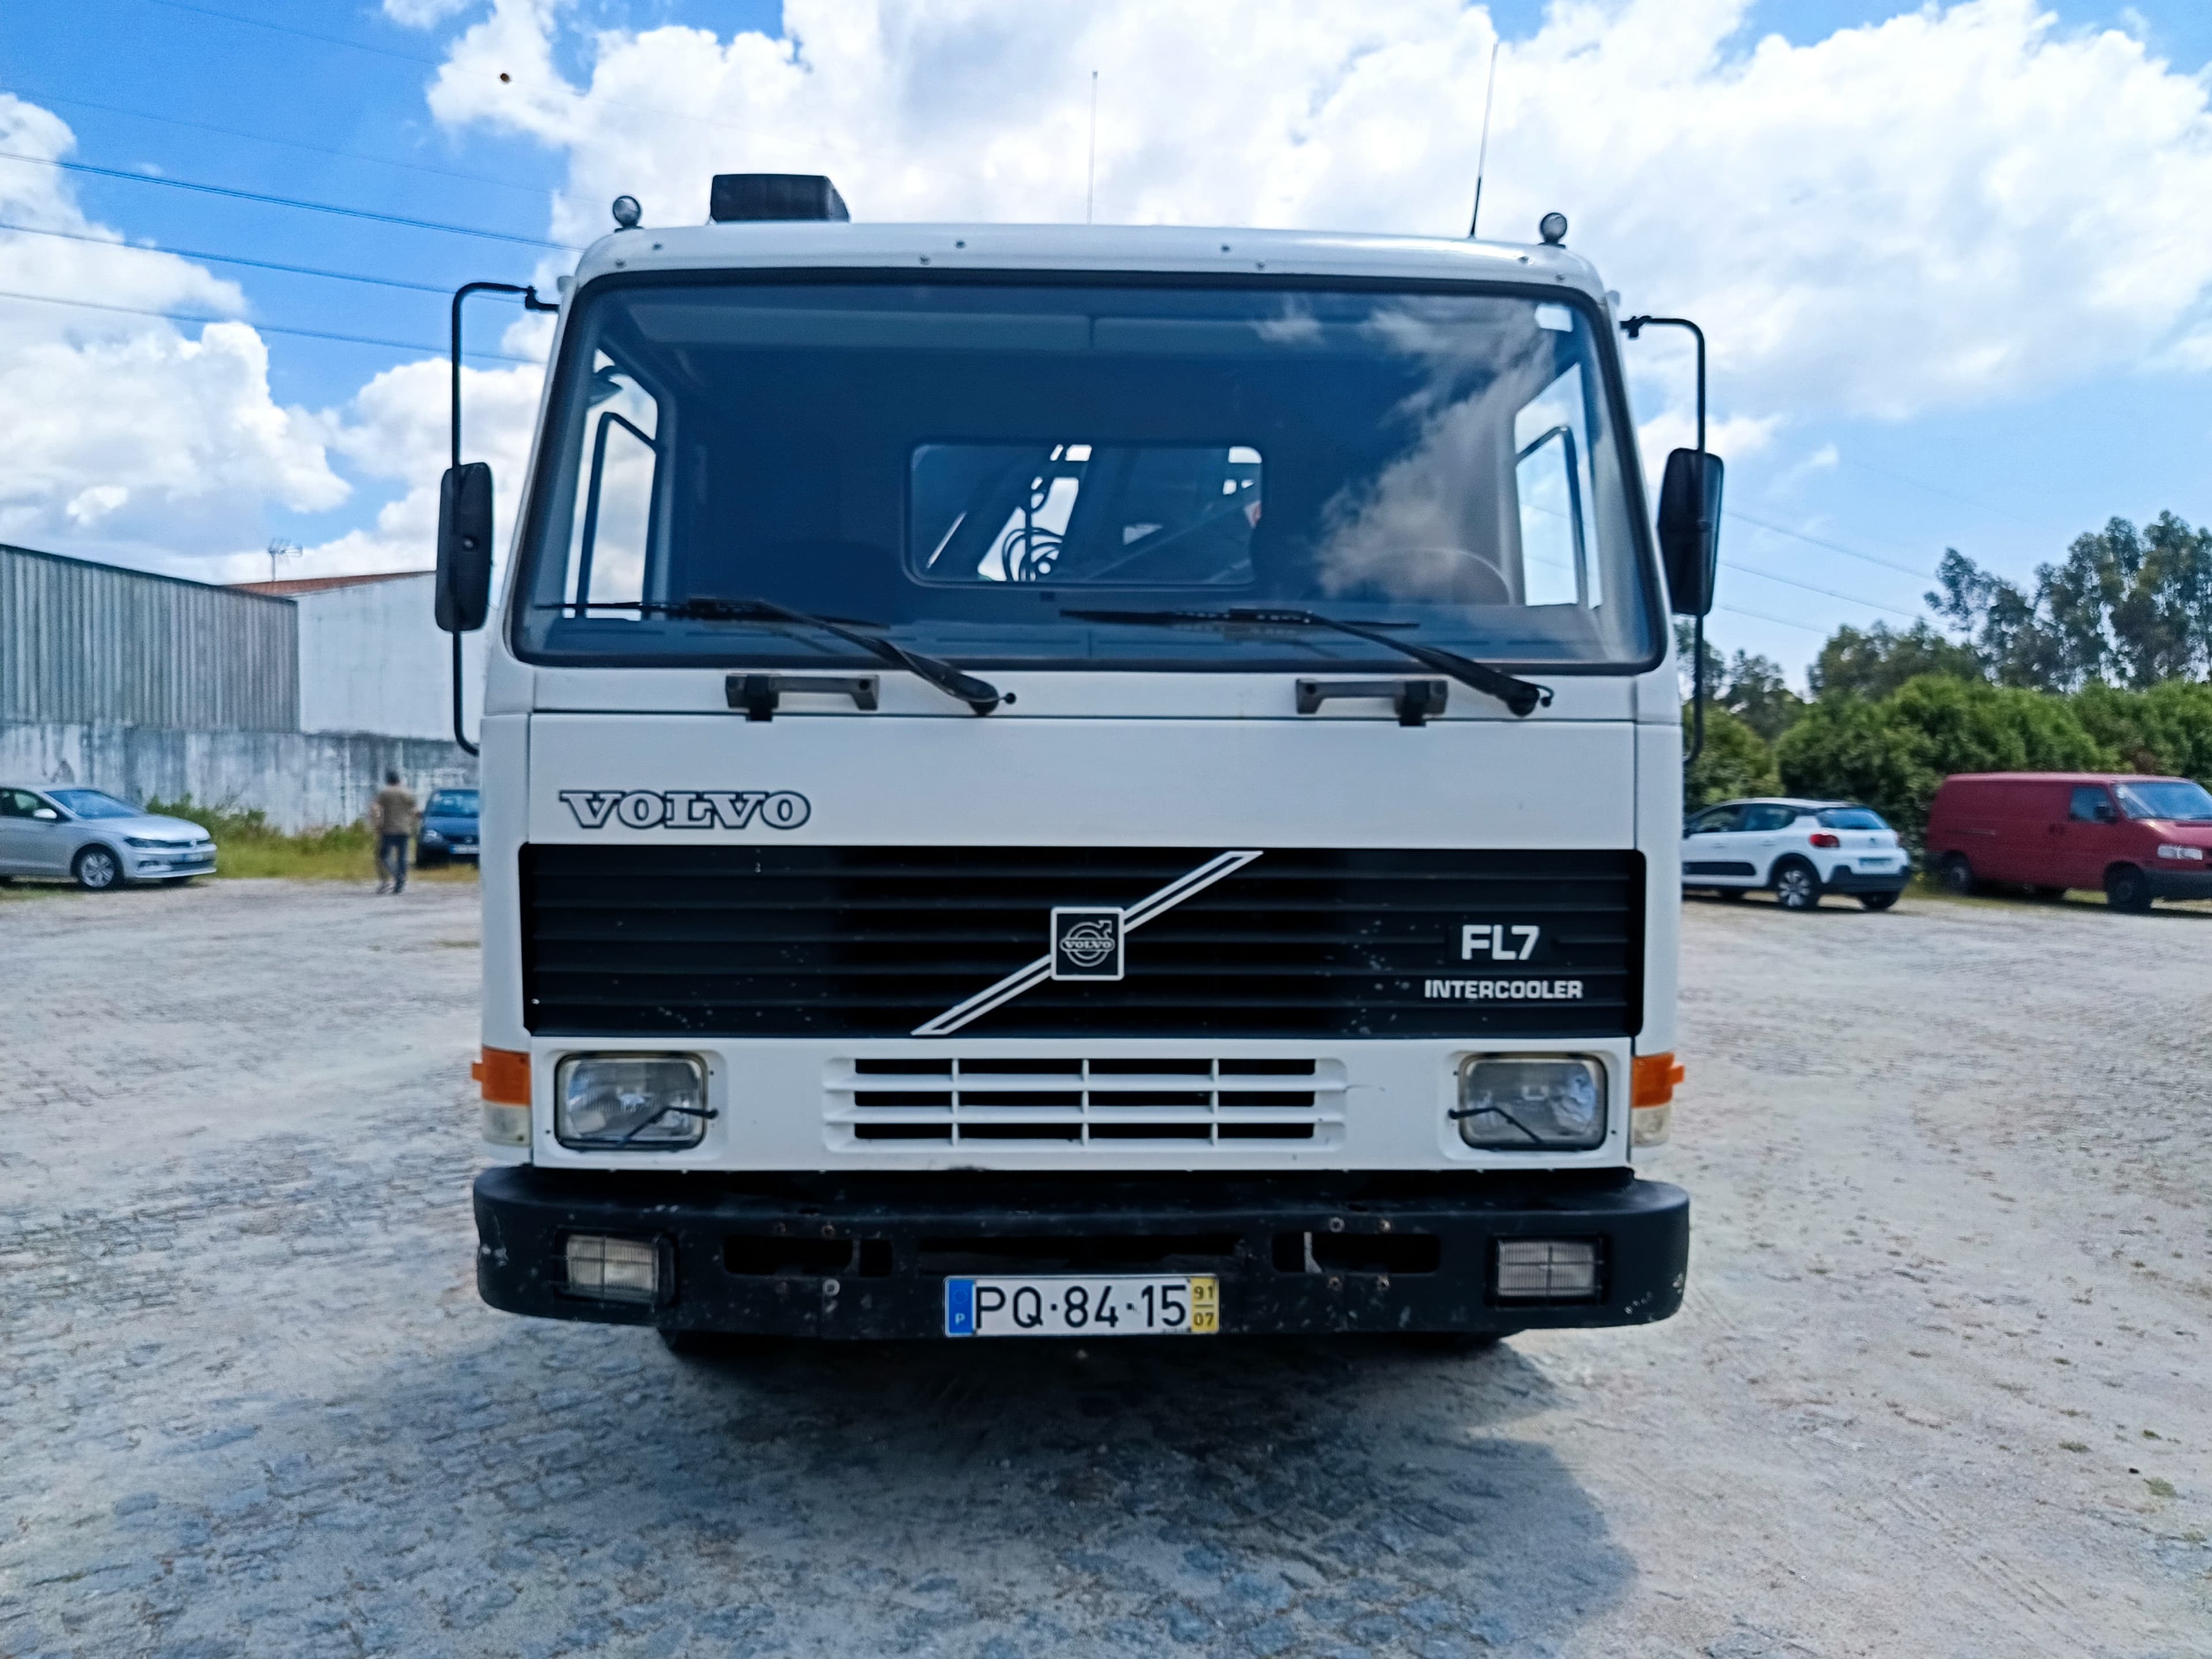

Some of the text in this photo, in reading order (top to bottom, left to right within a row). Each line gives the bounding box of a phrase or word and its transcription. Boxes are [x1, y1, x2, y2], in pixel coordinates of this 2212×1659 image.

[559, 790, 811, 829] VOLVO
[1064, 940, 1112, 949] VOLVO
[1462, 925, 1540, 960] FL7
[1425, 980, 1584, 999] INTERCOOLER
[1194, 1285, 1213, 1300] 91
[955, 1313, 966, 1326] P
[1194, 1312, 1214, 1327] 07
